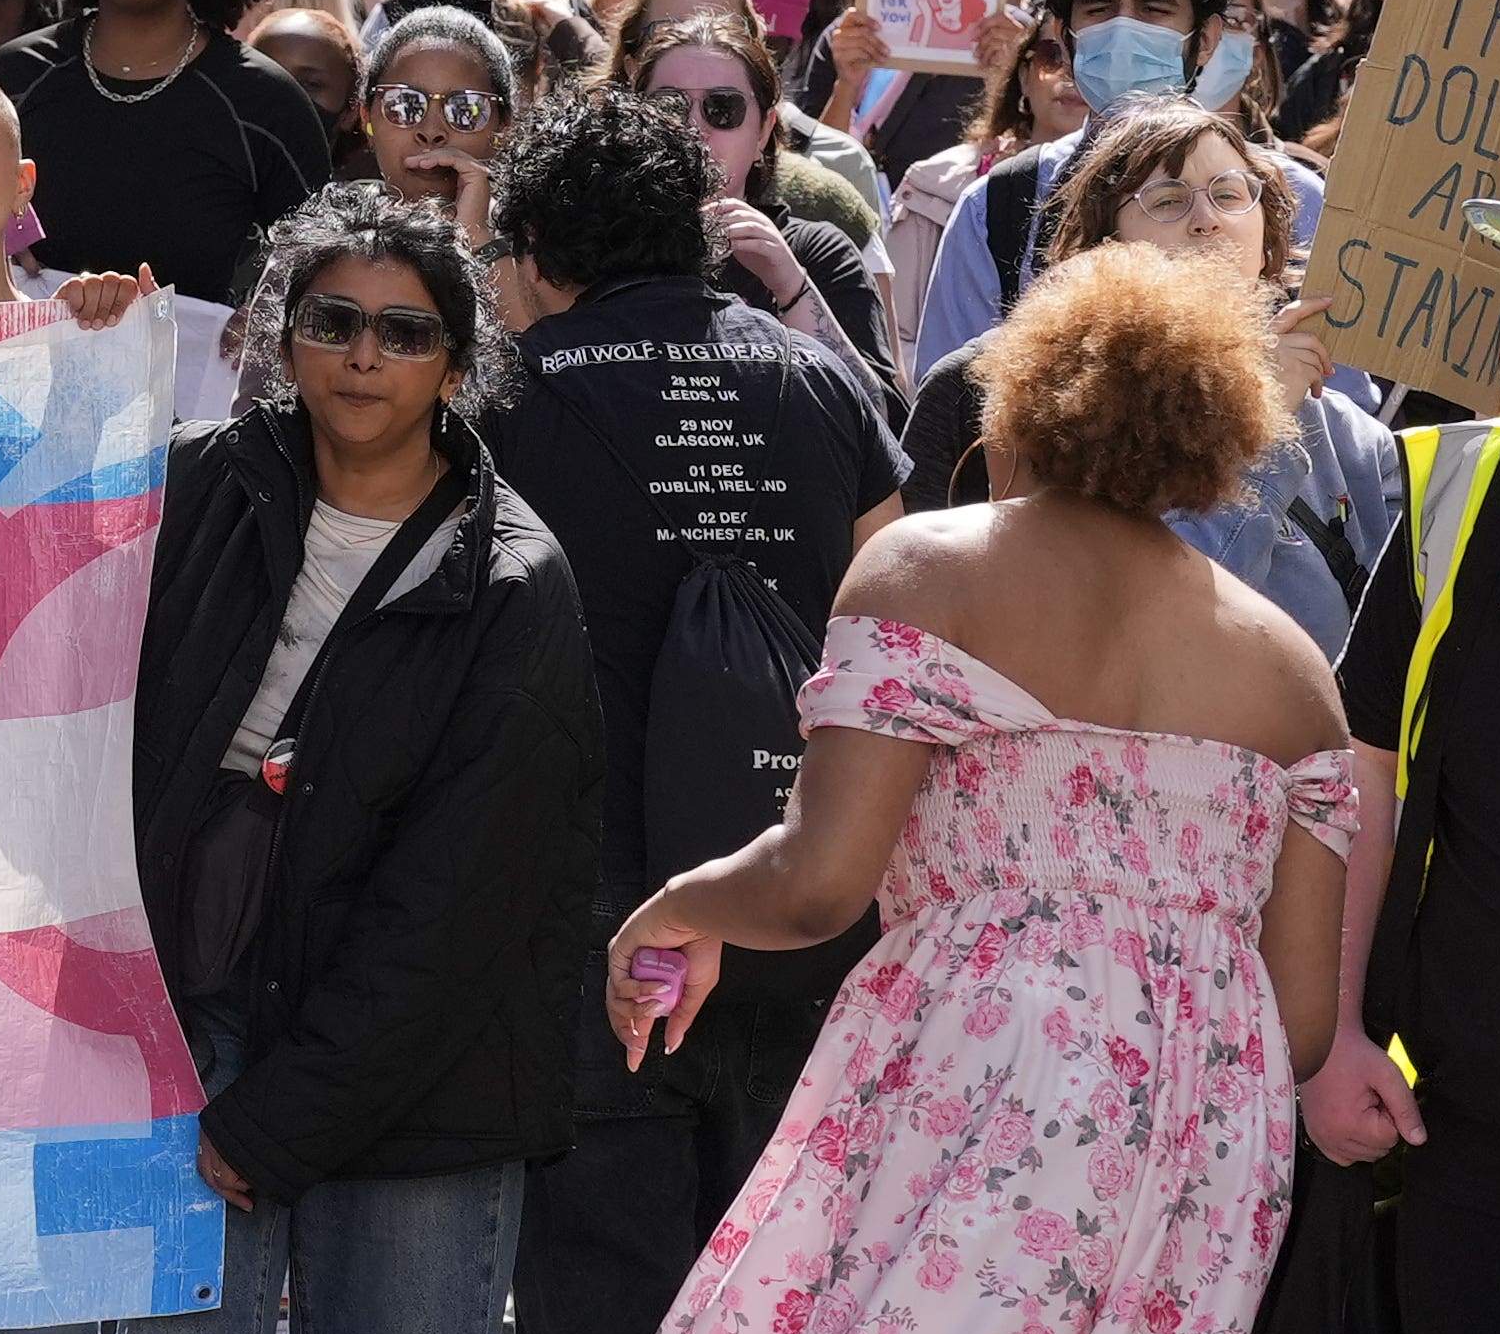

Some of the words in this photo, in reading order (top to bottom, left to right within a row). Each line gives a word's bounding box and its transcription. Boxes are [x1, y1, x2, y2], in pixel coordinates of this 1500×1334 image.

[540, 349, 589, 374] REMI
[590, 340, 654, 364] WOLF
[666, 343, 711, 362] BIG
[715, 342, 779, 362] IDEAS
[670, 374, 689, 388] 28
[689, 375, 722, 389] NOV
[661, 389, 716, 403] LEEDS,
[718, 389, 741, 403] UK
[679, 419, 698, 433] 29
[700, 419, 734, 433] NOV
[654, 433, 741, 449] GLASGOW,
[741, 433, 766, 447] UK
[688, 464, 706, 478] 01
[711, 464, 745, 478] DEC
[649, 481, 716, 496] DUBLIN,
[697, 511, 717, 525] 02
[773, 528, 796, 542] UK
[763, 578, 779, 592] K
